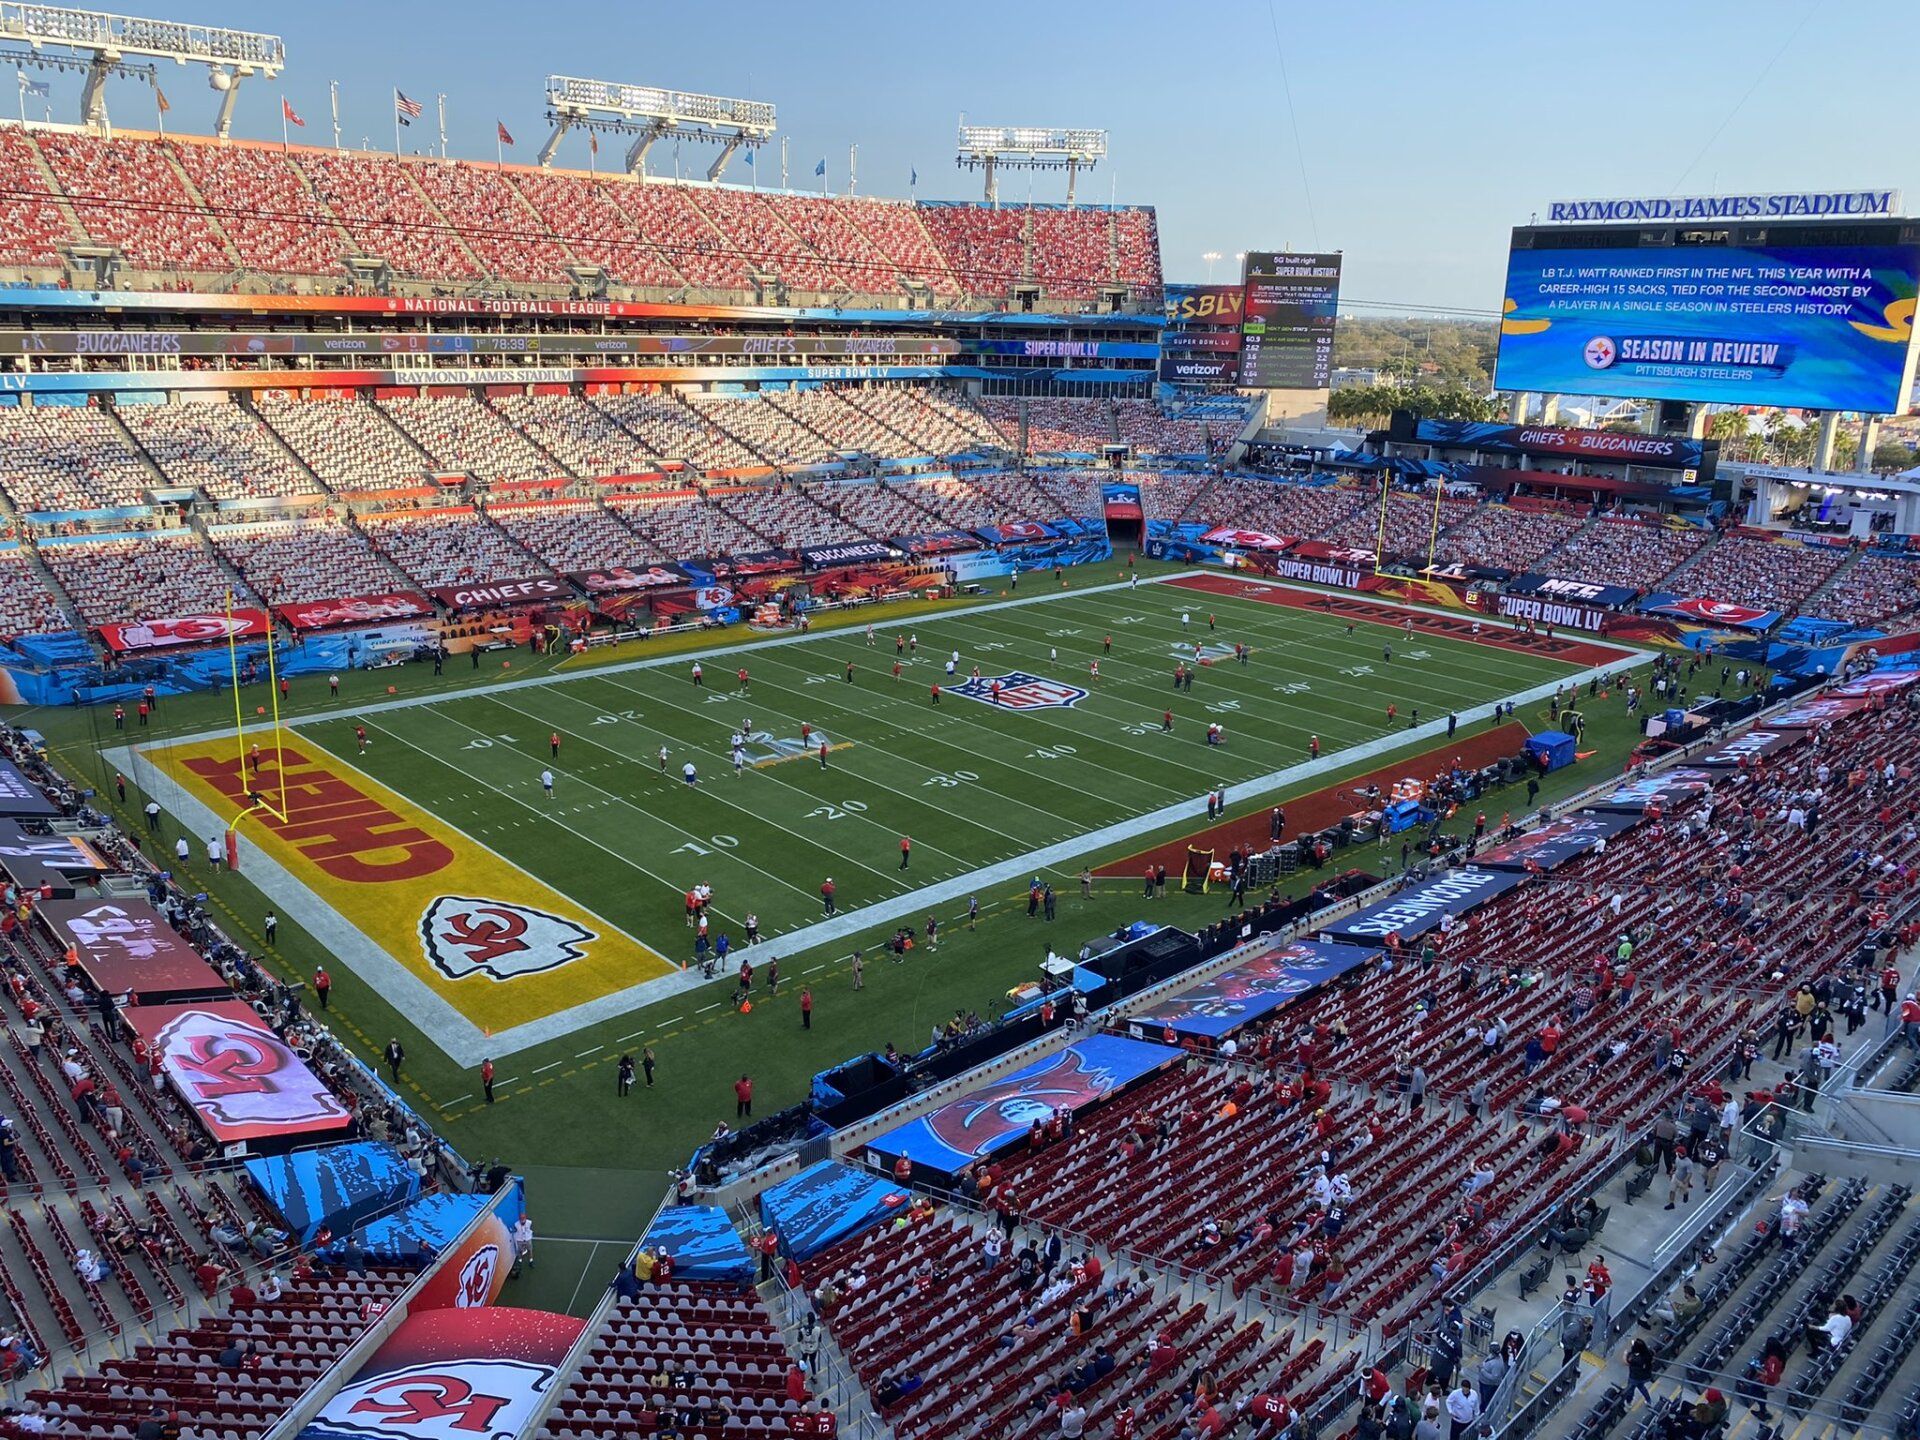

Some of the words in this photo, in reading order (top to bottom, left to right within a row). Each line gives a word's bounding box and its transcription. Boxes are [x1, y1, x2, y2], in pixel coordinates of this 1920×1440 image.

[1550, 200, 1672, 221] RAYMOND
[1674, 196, 1762, 219] JAMES
[1766, 192, 1892, 216] STADIUM
[1300, 257, 1316, 265] right
[1276, 267, 1294, 276] SUPER
[1296, 267, 1311, 276] BOWL
[1313, 267, 1338, 276] HISTORY
[1542, 268, 1555, 277] LB
[1558, 268, 1575, 278] T.J.
[1578, 268, 1608, 278] WATT
[1609, 268, 1654, 278] RANKED
[1656, 268, 1689, 278] FIRST
[1691, 268, 1703, 278] IN
[1706, 268, 1730, 278] THE
[1731, 268, 1754, 279] NFL
[1758, 268, 1786, 279] THIS
[1789, 268, 1822, 279] YEAR
[1825, 268, 1860, 279] WITH
[1861, 268, 1872, 279] A
[1539, 284, 1609, 294] CAREER-HIGH
[1613, 285, 1626, 294] 15
[1628, 285, 1668, 296] SACKS,
[1671, 285, 1697, 295] TIED
[1699, 285, 1724, 295] FOR
[1727, 285, 1750, 295] THE
[1753, 285, 1849, 297] SECOND-MOST
[1852, 286, 1872, 297] BY
[404, 299, 475, 313] NATIONAL
[483, 300, 554, 314] FOOTBALL
[562, 301, 610, 314] LEAGUE
[1165, 292, 1243, 319] #SBLV
[1548, 300, 1556, 309] A
[1558, 300, 1598, 310] PLAYER
[1600, 301, 1612, 310] IN
[1613, 301, 1621, 310] A
[1623, 301, 1662, 311] SINGLE
[1665, 302, 1713, 312] SEASON
[1715, 303, 1727, 312] IN
[1730, 303, 1792, 314] STEELERS
[1794, 304, 1852, 315] HISTORY
[76, 334, 181, 352] BUCCANEERS
[324, 338, 366, 349] verizon
[409, 337, 417, 348] 0
[454, 336, 463, 348] 0
[492, 338, 525, 350] 78:39
[595, 338, 628, 349] verizon
[743, 339, 796, 353] CHIEFS
[845, 339, 896, 353] BUCCANEERS
[1025, 341, 1057, 355] SUPER
[1058, 341, 1085, 356] BOWL
[1087, 342, 1099, 356] LV
[1621, 339, 1685, 361] SEASON
[1688, 341, 1706, 361] IN
[1711, 342, 1779, 365] REVIEW
[397, 371, 469, 384] RAYMOND
[471, 370, 514, 383] JAMES
[517, 369, 572, 382] STADIUM
[808, 368, 841, 378] SUPER
[846, 368, 872, 377] BOWL
[877, 368, 888, 377] LV
[1176, 363, 1220, 375] verizon
[1635, 365, 1699, 377] PITTSBURGH
[1700, 368, 1753, 380] STEELERS
[4, 376, 27, 389] LV
[1519, 430, 1565, 446] CHIEFS
[1579, 435, 1673, 455] BUCCANEERS
[807, 542, 892, 563] BUCCANEERS
[1277, 558, 1311, 582] SUPER
[1312, 565, 1343, 587] BOWL
[1345, 571, 1360, 588] LV
[455, 580, 558, 605] CHIEFS
[1537, 579, 1605, 596] NFC
[1468, 593, 1477, 601] 25
[1499, 595, 1542, 620] SUPER
[1543, 603, 1582, 628] BOWL
[1584, 610, 1604, 631] LV
[983, 684, 1076, 707] NFL
[1206, 700, 1241, 713] 40
[1122, 721, 1163, 736] 50
[1034, 744, 1077, 760] 40
[1705, 732, 1781, 762] CHIEFS
[930, 770, 980, 789] 30
[180, 747, 455, 883] CHIEFS
[814, 800, 868, 821] 20
[680, 834, 740, 857] 10
[1347, 872, 1496, 936] BUCCANEERS
[1281, 1089, 1291, 1098] 99
[1703, 1149, 1717, 1161] 12
[1330, 1210, 1341, 1220] 12
[660, 1265, 670, 1276] 12
[1078, 1272, 1087, 1284] 10
[1265, 1398, 1279, 1413] 12
[818, 1424, 830, 1433] 12
